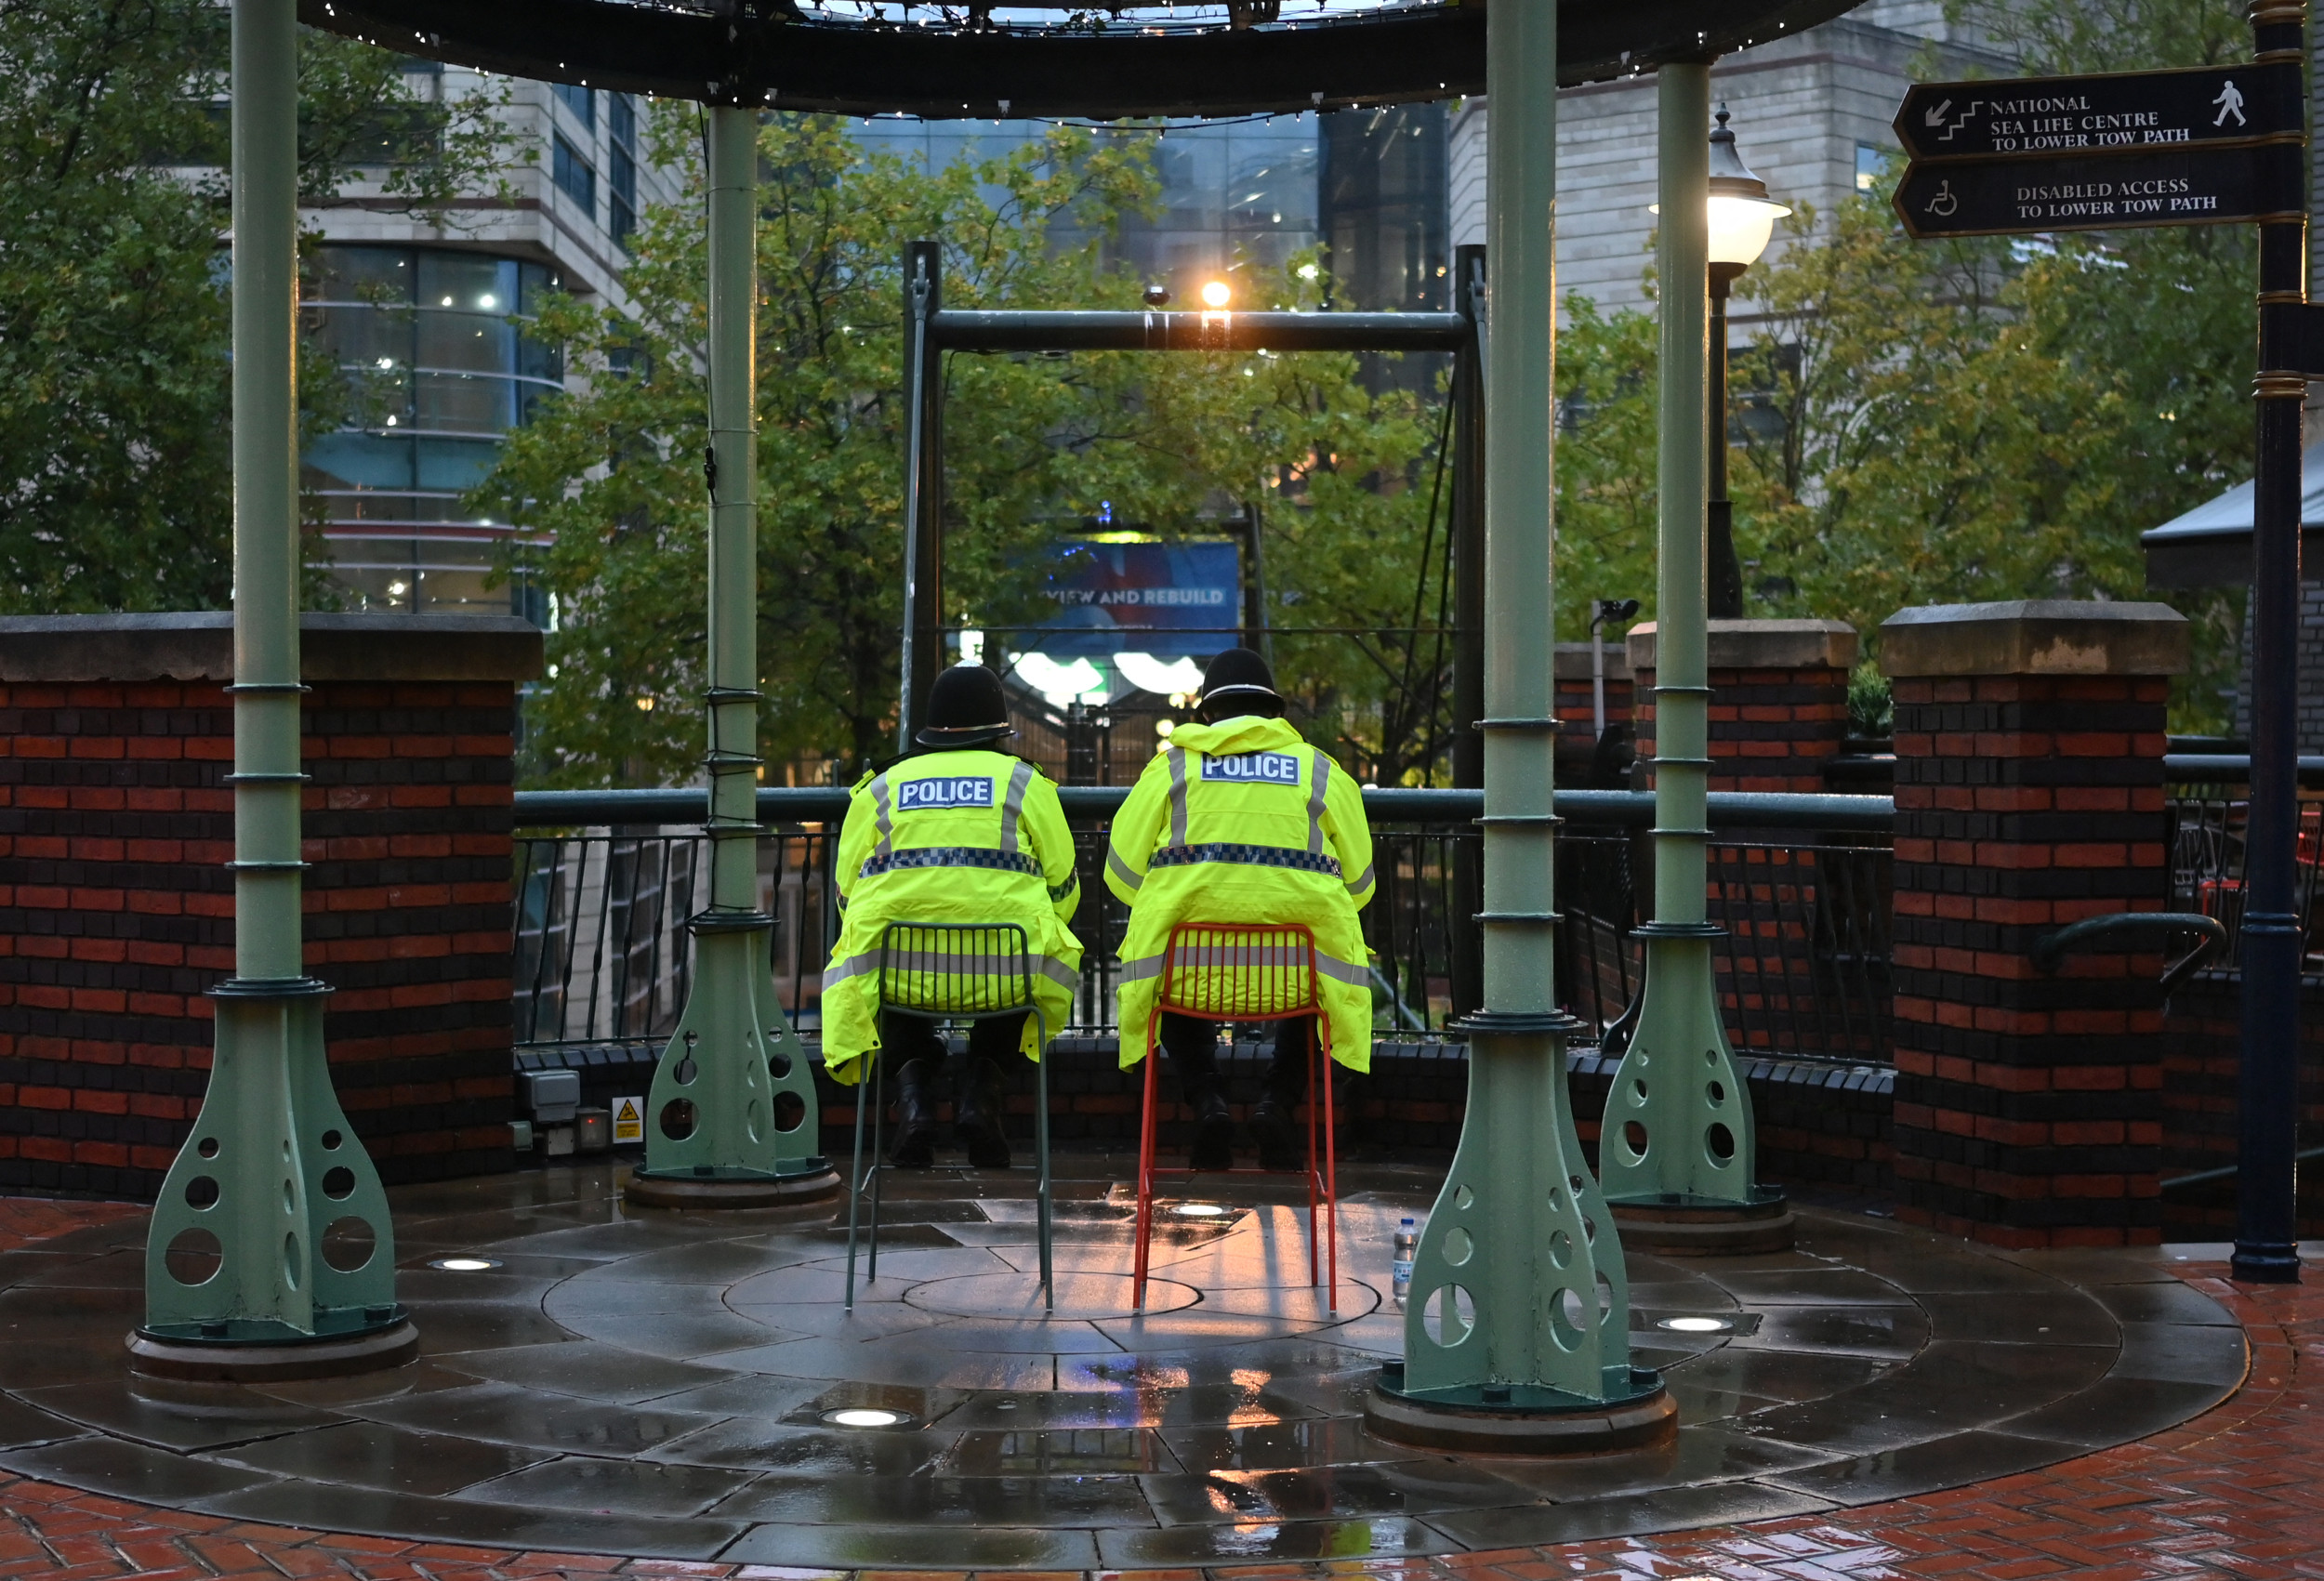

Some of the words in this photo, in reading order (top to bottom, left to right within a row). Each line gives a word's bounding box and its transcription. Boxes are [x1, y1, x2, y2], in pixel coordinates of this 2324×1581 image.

[1990, 97, 2090, 114] NATIONAL
[1991, 120, 2026, 135] SEA
[2033, 117, 2073, 133] LIFE
[2081, 112, 2159, 129] CENTRE
[1992, 138, 2016, 151] TO
[2024, 134, 2089, 149] LOWER
[2095, 131, 2136, 145] TOW
[2144, 128, 2189, 144] PATH
[2017, 183, 2112, 201] DISABLED
[2118, 178, 2189, 196] ACCESS
[2017, 204, 2042, 218] TO
[2049, 202, 2115, 217] LOWER
[2121, 199, 2163, 213] TOW
[2171, 196, 2217, 211] PATH
[1100, 589, 1140, 604] AND
[1143, 589, 1224, 604] REBUILD
[1206, 755, 1295, 779] POLICE
[902, 780, 988, 804] POLICE
